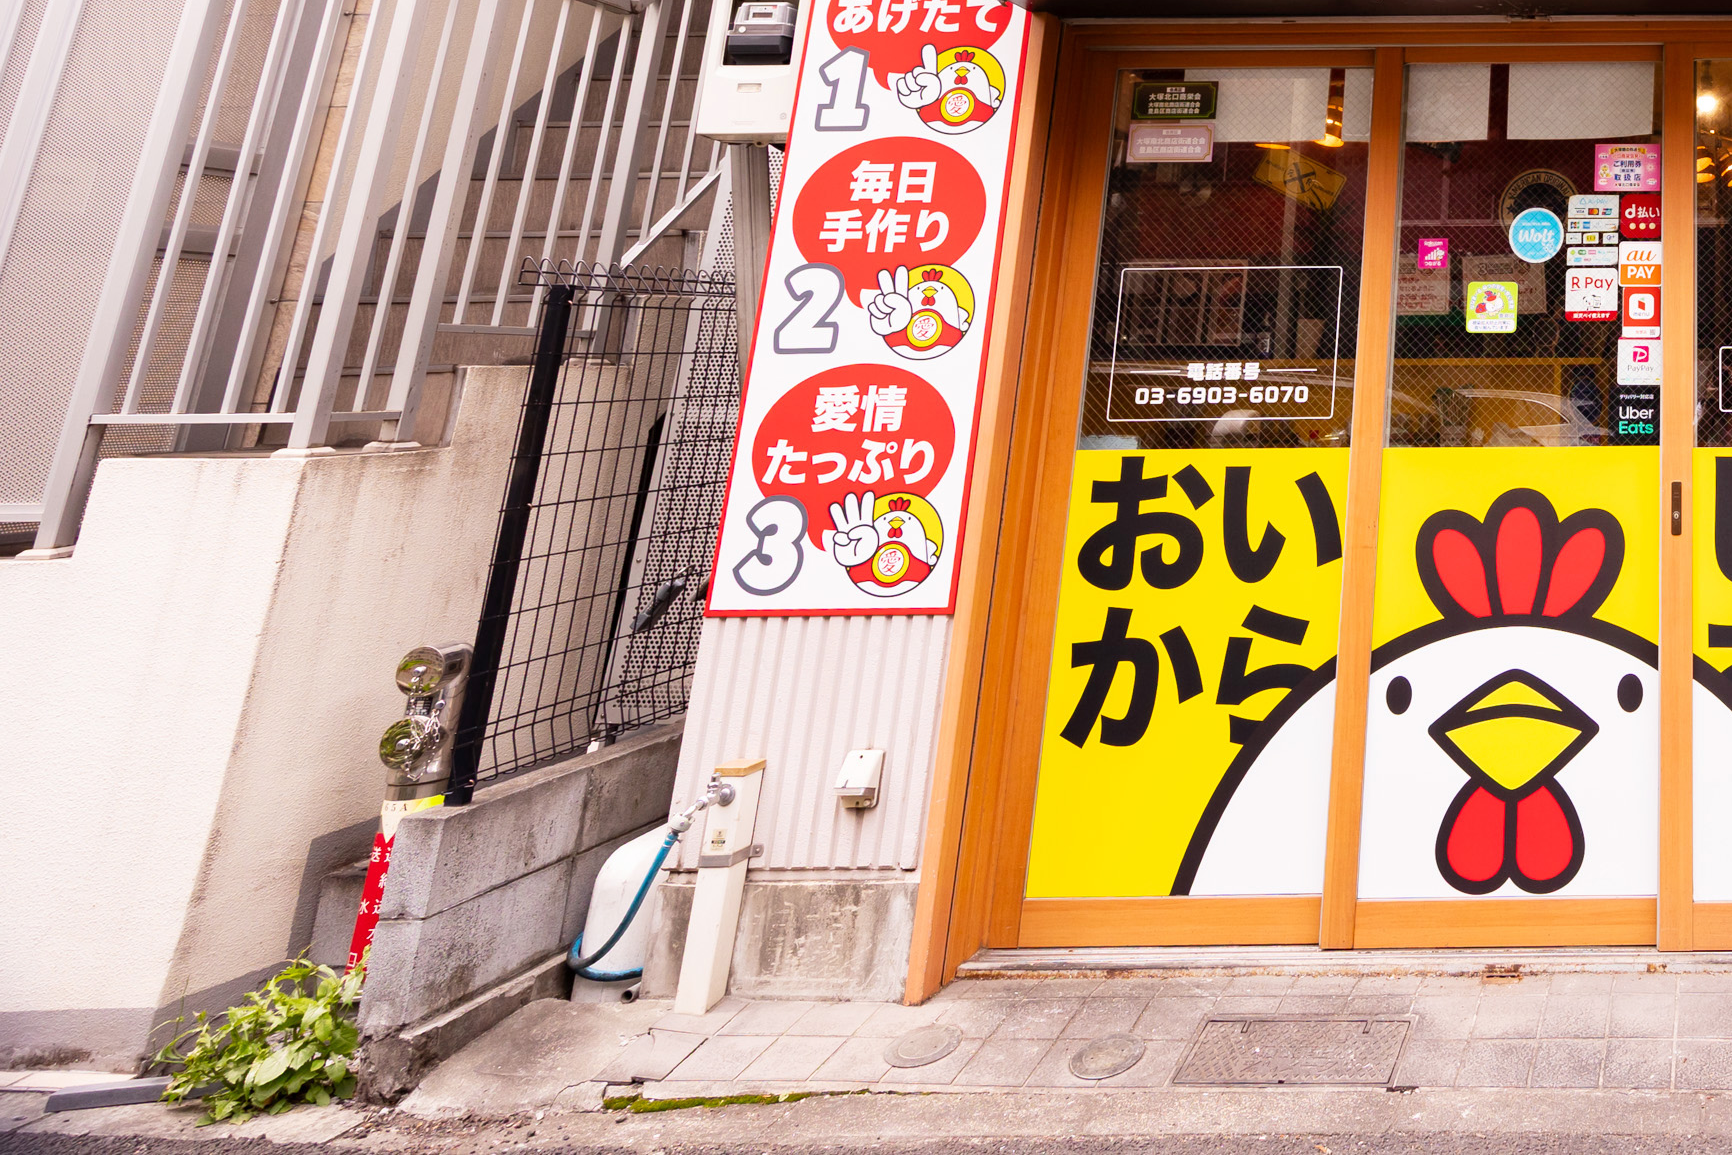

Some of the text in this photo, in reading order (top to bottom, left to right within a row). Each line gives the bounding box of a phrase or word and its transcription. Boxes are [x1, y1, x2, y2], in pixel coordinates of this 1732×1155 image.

[815, 44, 871, 132] 1
[849, 159, 938, 204] 毎日
[1624, 204, 1661, 219] d払い
[818, 208, 951, 254] 手作り
[1518, 227, 1556, 244] Wolt
[1626, 250, 1657, 262] au
[1627, 266, 1656, 279] PAY
[1571, 276, 1614, 291] R Pay
[773, 262, 846, 354] 2
[1186, 362, 1261, 381] 電話番号
[1134, 386, 1310, 405] 03-6903-6070
[811, 385, 908, 433] 愛情
[1619, 406, 1655, 419] Uber
[1618, 421, 1654, 434] Eats
[761, 438, 936, 485] たっぷり
[1076, 455, 1343, 590] おい
[732, 495, 809, 596] 3
